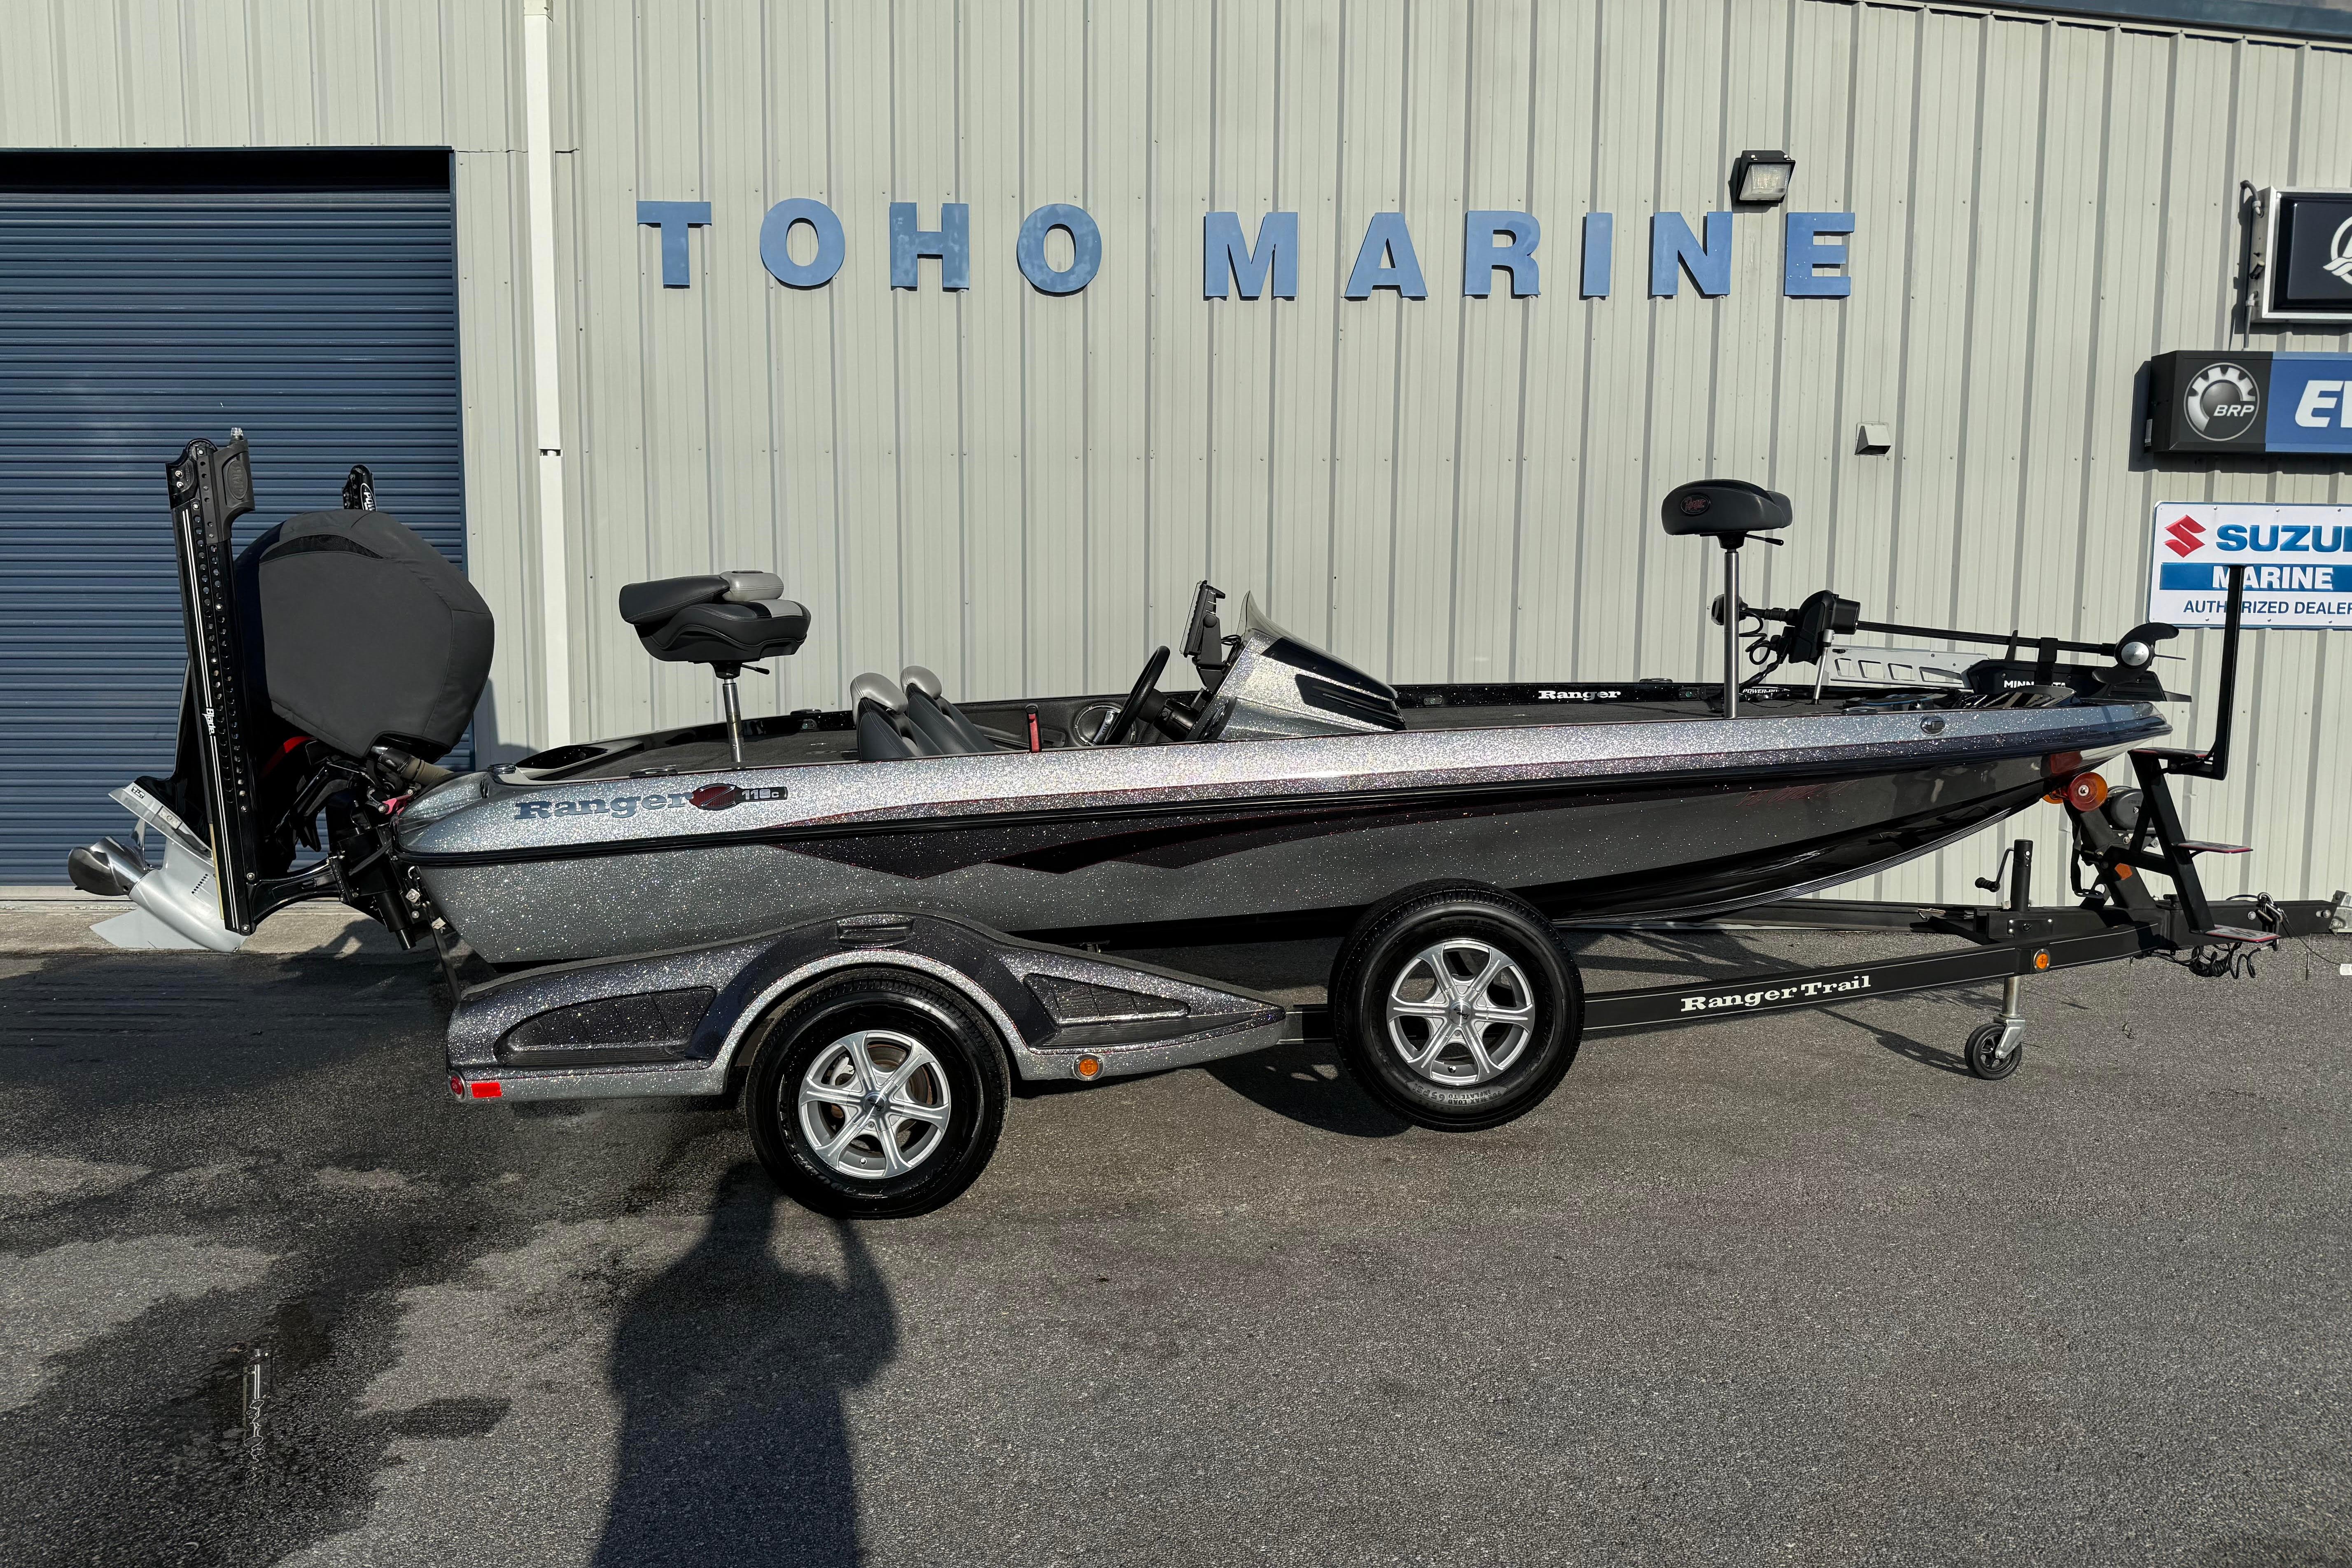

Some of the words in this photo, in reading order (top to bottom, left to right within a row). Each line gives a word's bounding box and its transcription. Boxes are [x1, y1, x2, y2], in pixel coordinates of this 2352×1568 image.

[637, 198, 1102, 292] TOHO
[1204, 210, 1855, 299] MARINE
[2213, 405, 2255, 417] BRP
[2295, 380, 2352, 428] E
[2212, 566, 2333, 589] MARINE
[2184, 600, 2289, 614] AUTHRIZED
[1538, 691, 1621, 700] Ranger
[513, 792, 693, 819] Ranger
[1681, 987, 1797, 1012] Ranger
[1801, 975, 1871, 996] Trail
